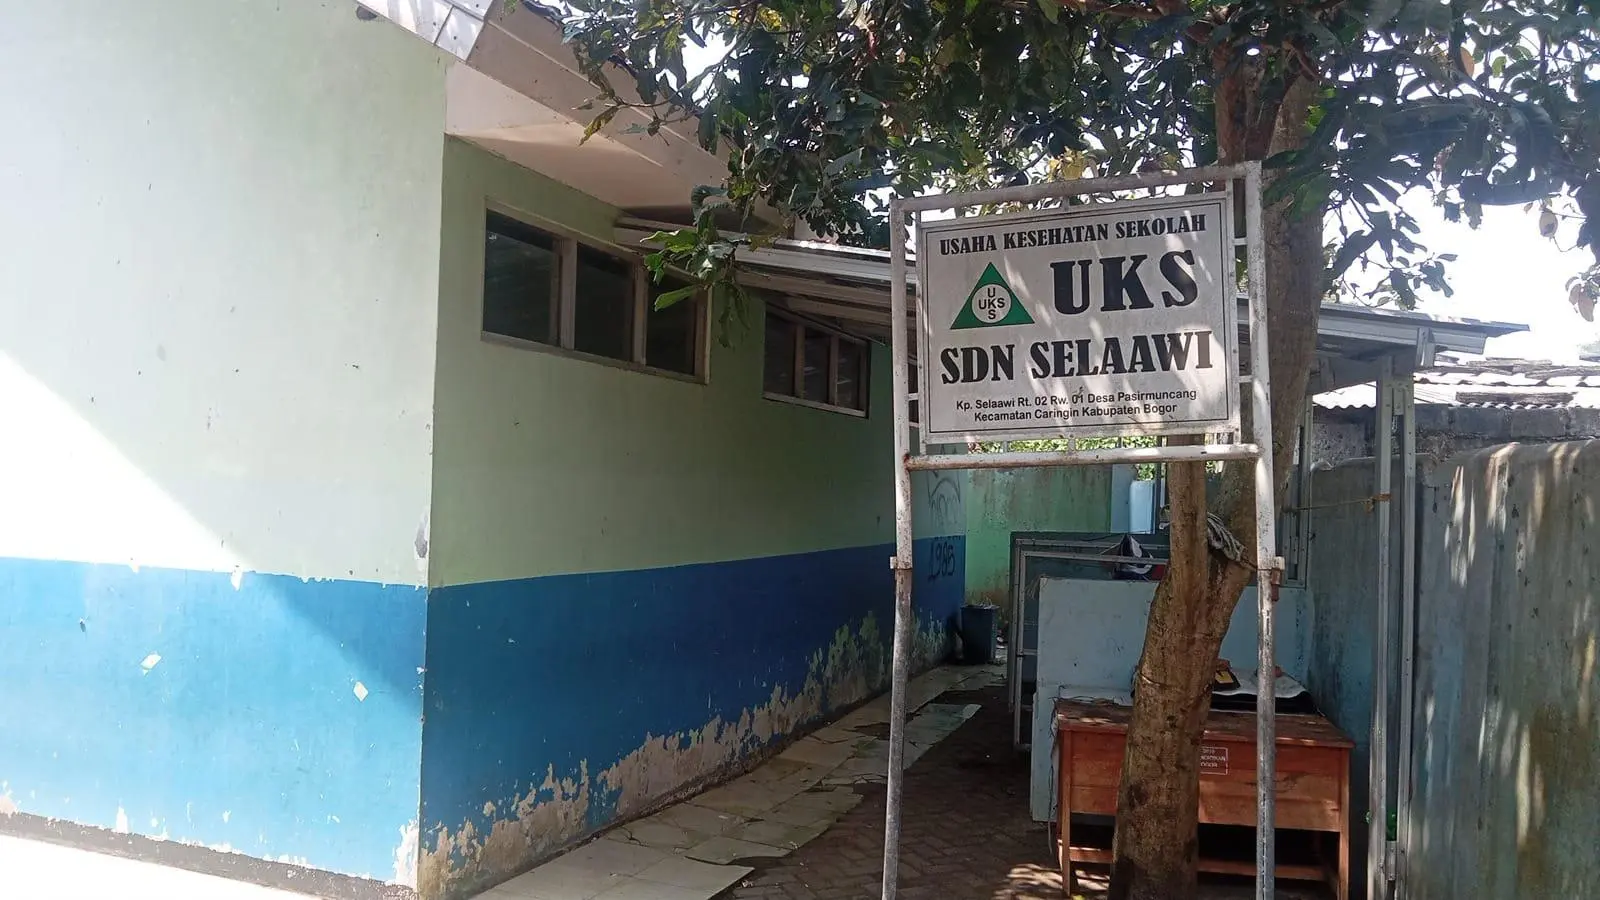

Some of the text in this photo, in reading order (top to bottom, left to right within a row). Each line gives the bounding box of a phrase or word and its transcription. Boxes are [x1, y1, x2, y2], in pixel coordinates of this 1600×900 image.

[940, 214, 1206, 256] USAHA KESEHATAN SEKOLAH
[1050, 250, 1198, 314] UKS
[978, 297, 1005, 310] UKS
[940, 331, 1212, 385] SDN SELAAWI
[956, 389, 1197, 411] Kp. Selaawi Rt. 02 Rw. 01 Desa Pasirmuncang
[974, 403, 1178, 422] Kecamatan Caringin Kabupaten Bogor
